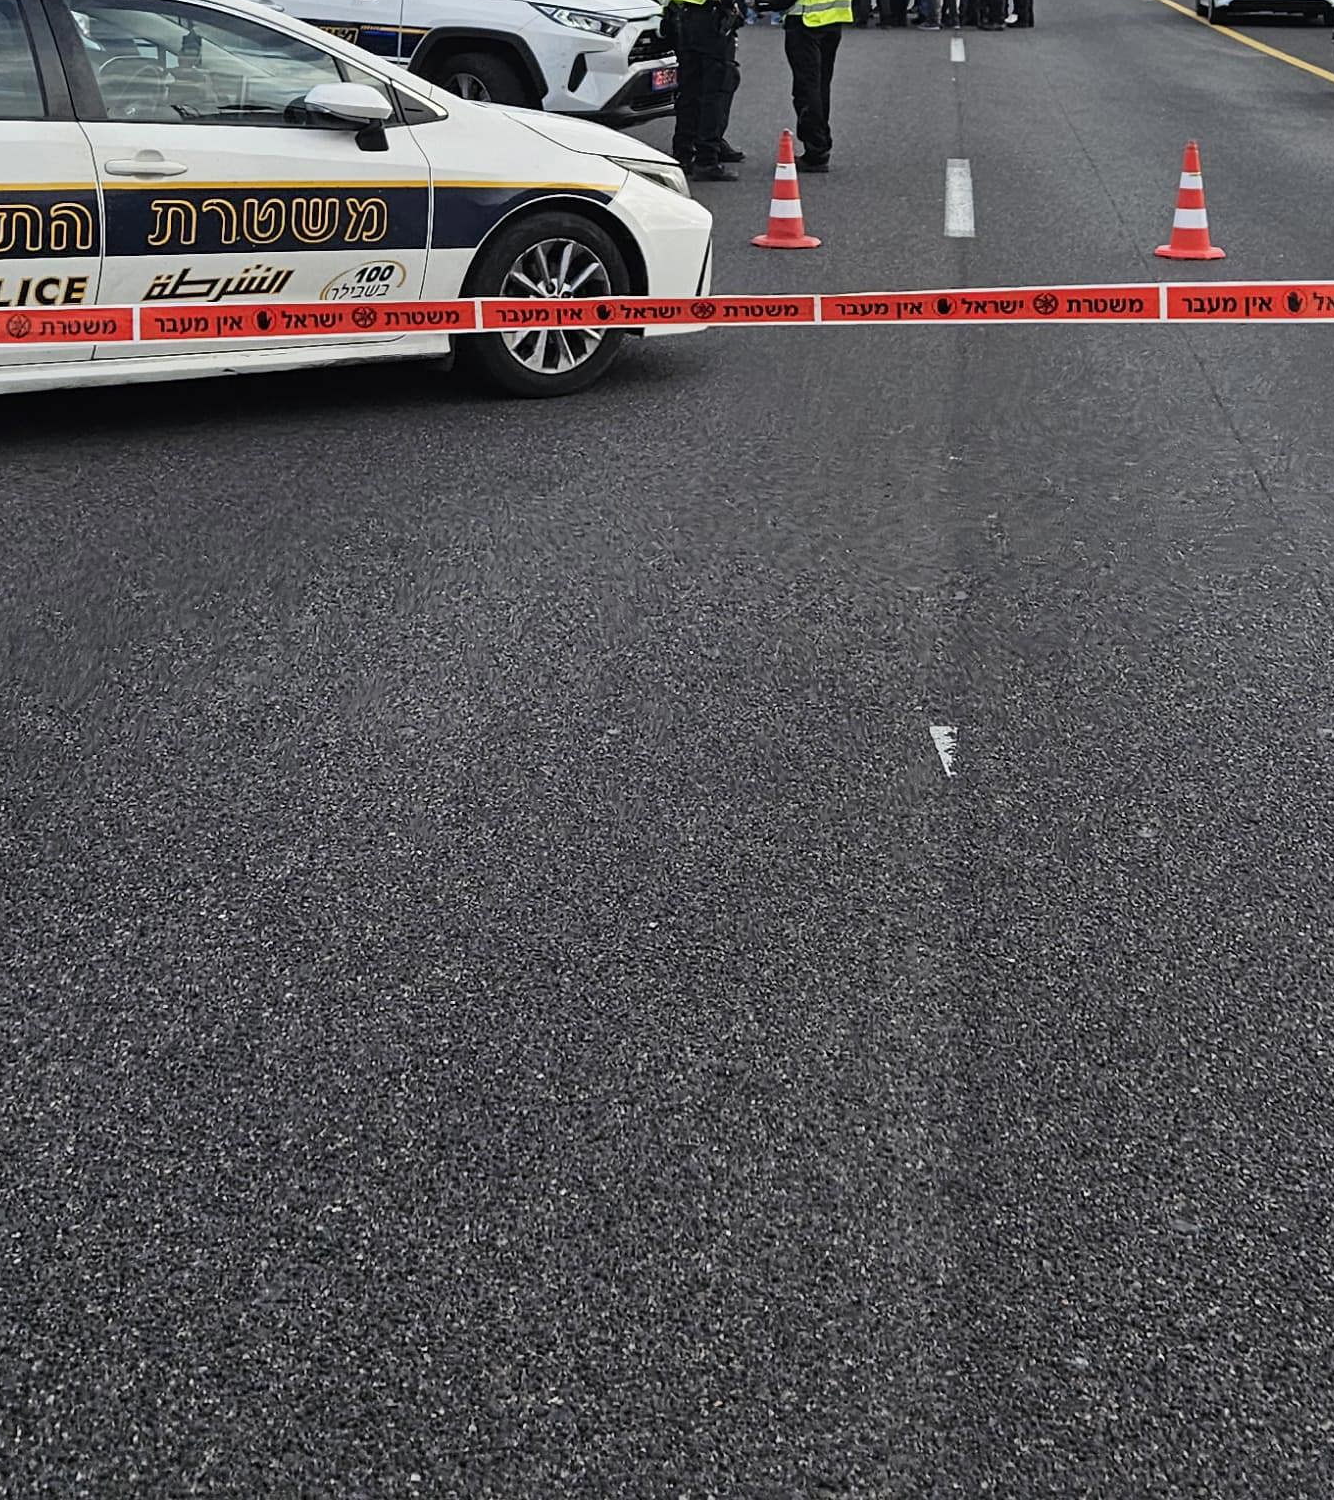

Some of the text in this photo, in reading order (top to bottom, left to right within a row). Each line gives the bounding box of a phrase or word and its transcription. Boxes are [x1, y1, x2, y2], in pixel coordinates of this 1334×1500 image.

[147, 197, 388, 246] משטרת
[142, 263, 295, 303] الشرطة
[354, 264, 395, 283] 100
[331, 282, 390, 300] בשבילך
[496, 305, 799, 323] משטרת ישראל אין מעבר
[835, 298, 1143, 319] משטרת ישראל אין מעבר
[1182, 297, 1237, 313] מעבר
[1245, 297, 1272, 316] אין
[39, 320, 117, 335] משטרת
[155, 311, 459, 335] משטרת ישראל אין מעבר
